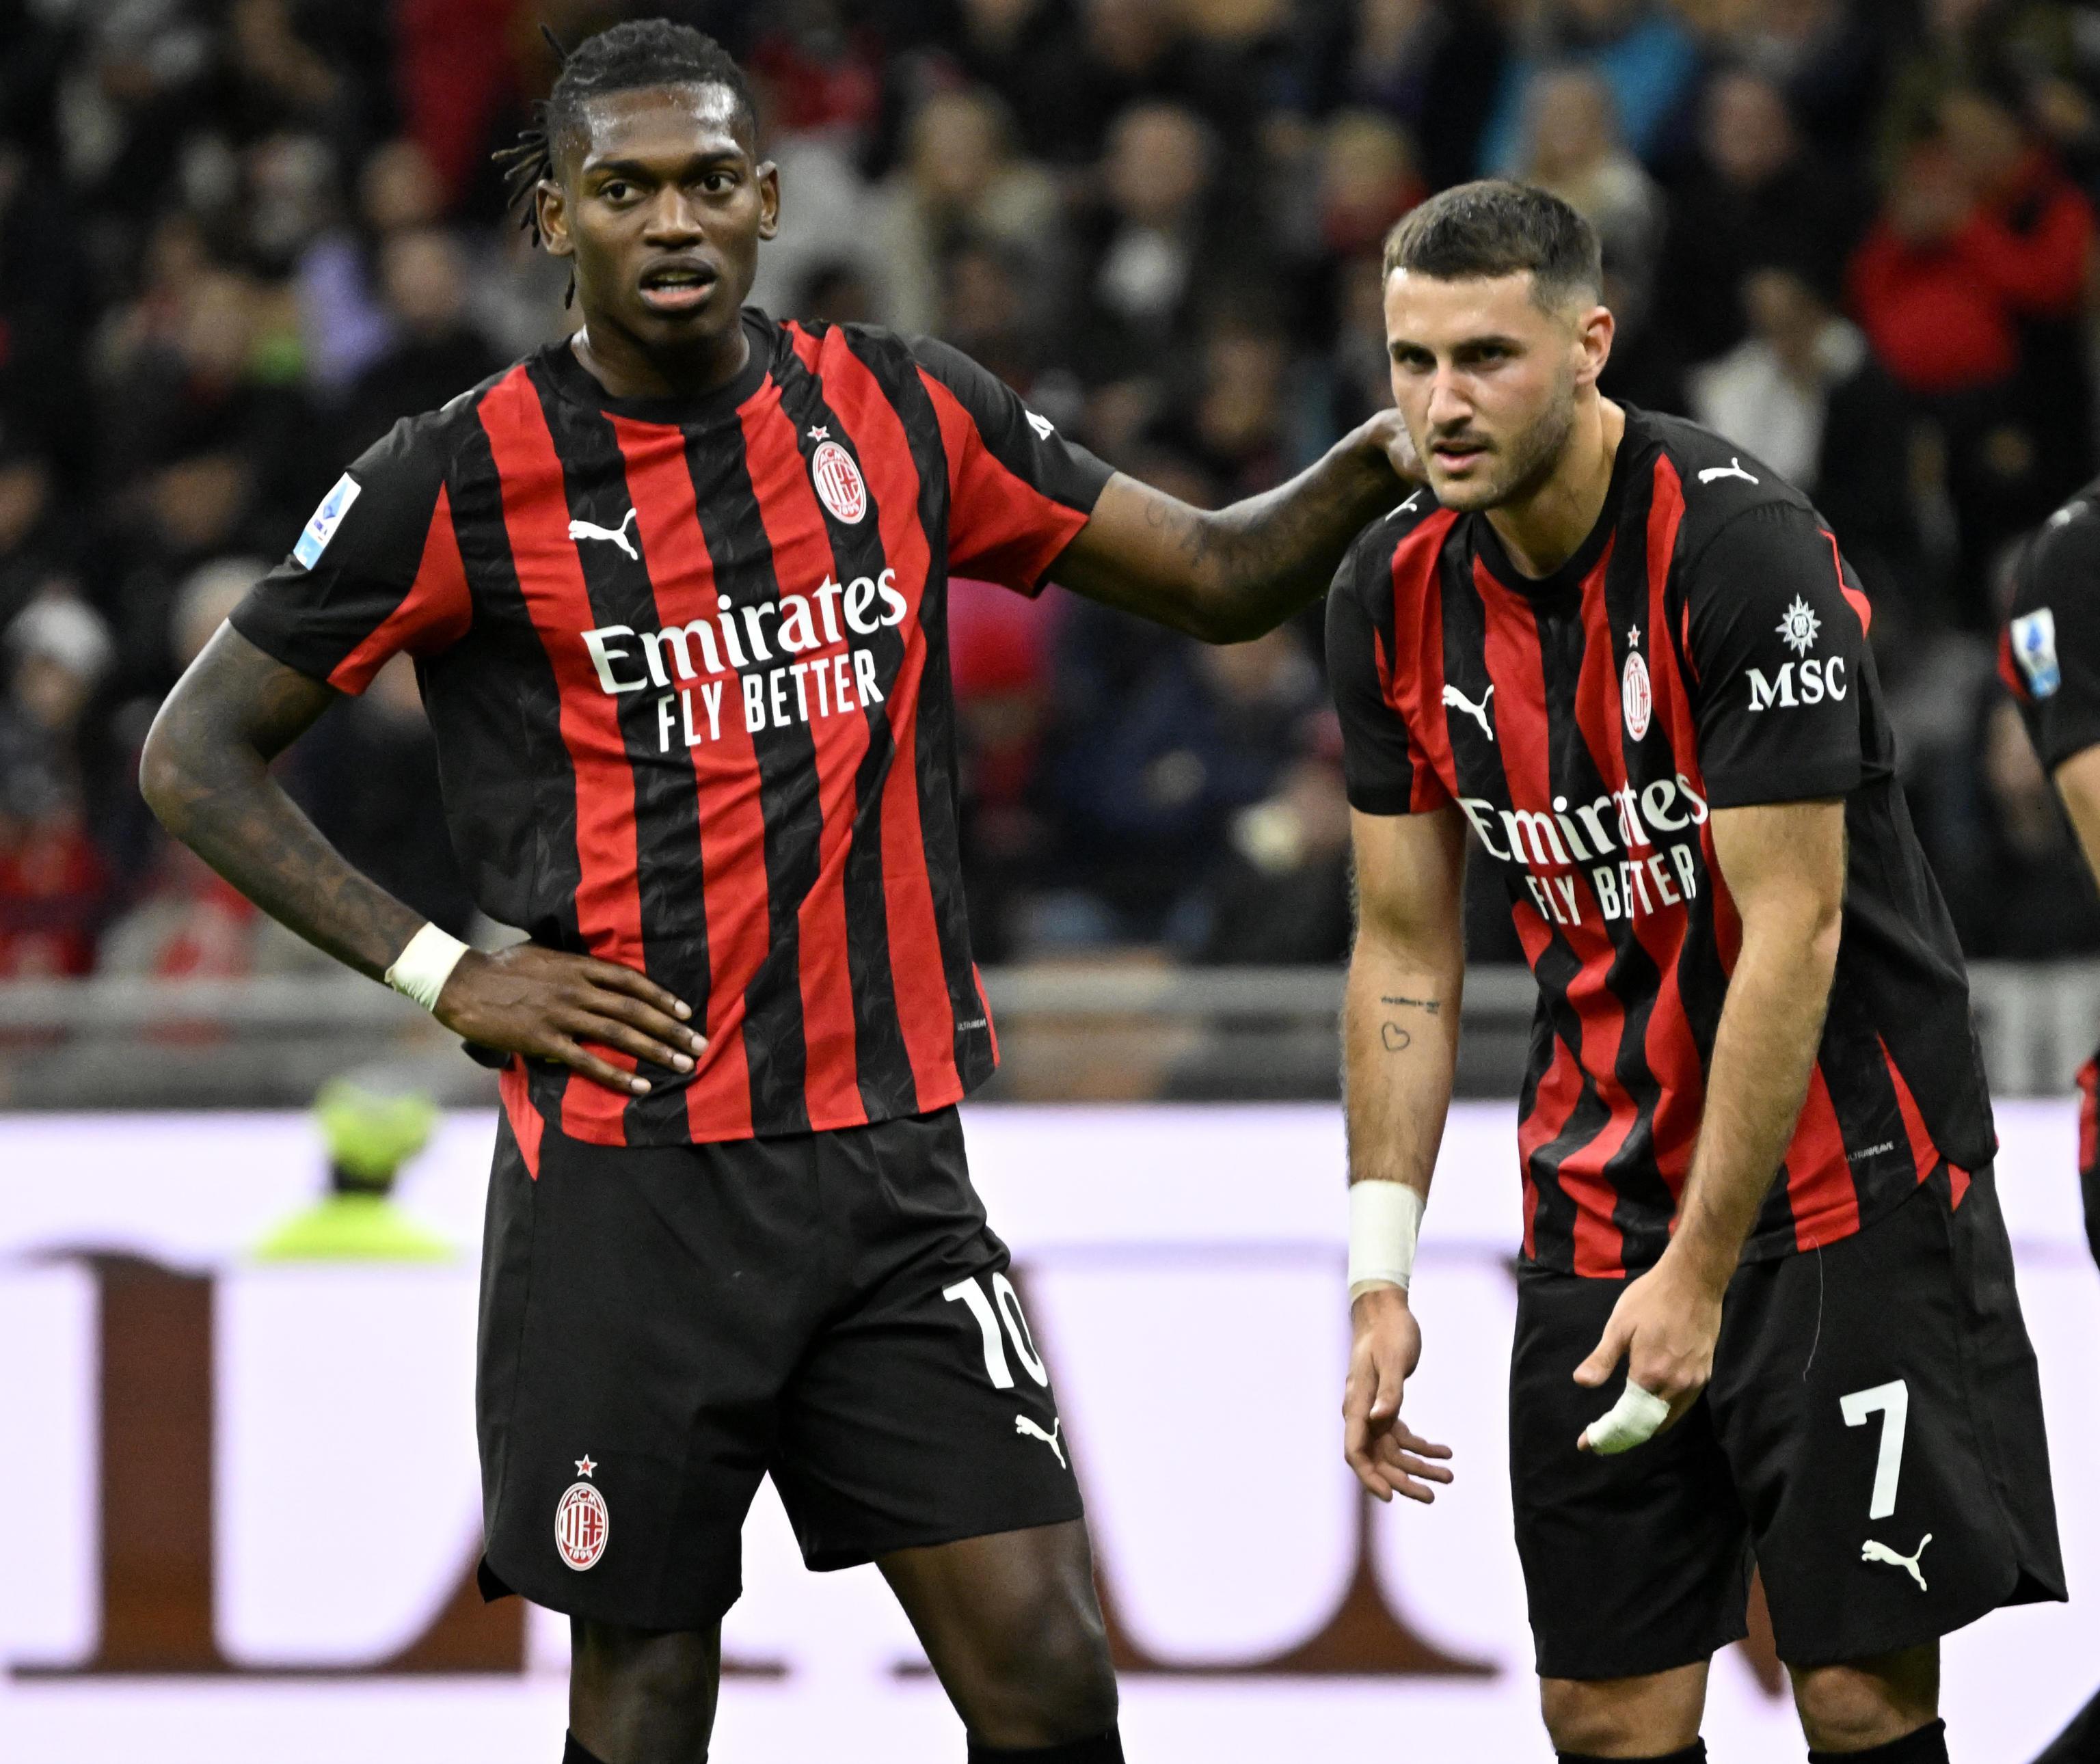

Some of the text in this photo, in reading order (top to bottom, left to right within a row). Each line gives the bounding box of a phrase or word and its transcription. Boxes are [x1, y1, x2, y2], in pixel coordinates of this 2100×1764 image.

[580, 567, 907, 694] Emirates
[657, 649, 885, 753] FLY BETTER
[1745, 655, 1847, 711] MSC
[1456, 773, 1708, 865] Emirates
[1525, 843, 1697, 926] FLY BETER
[942, 1271, 1049, 1389] 10
[1840, 1379, 1909, 1520] 7
[568, 1489, 597, 1507] ACM
[569, 1548, 593, 1560] 1899
